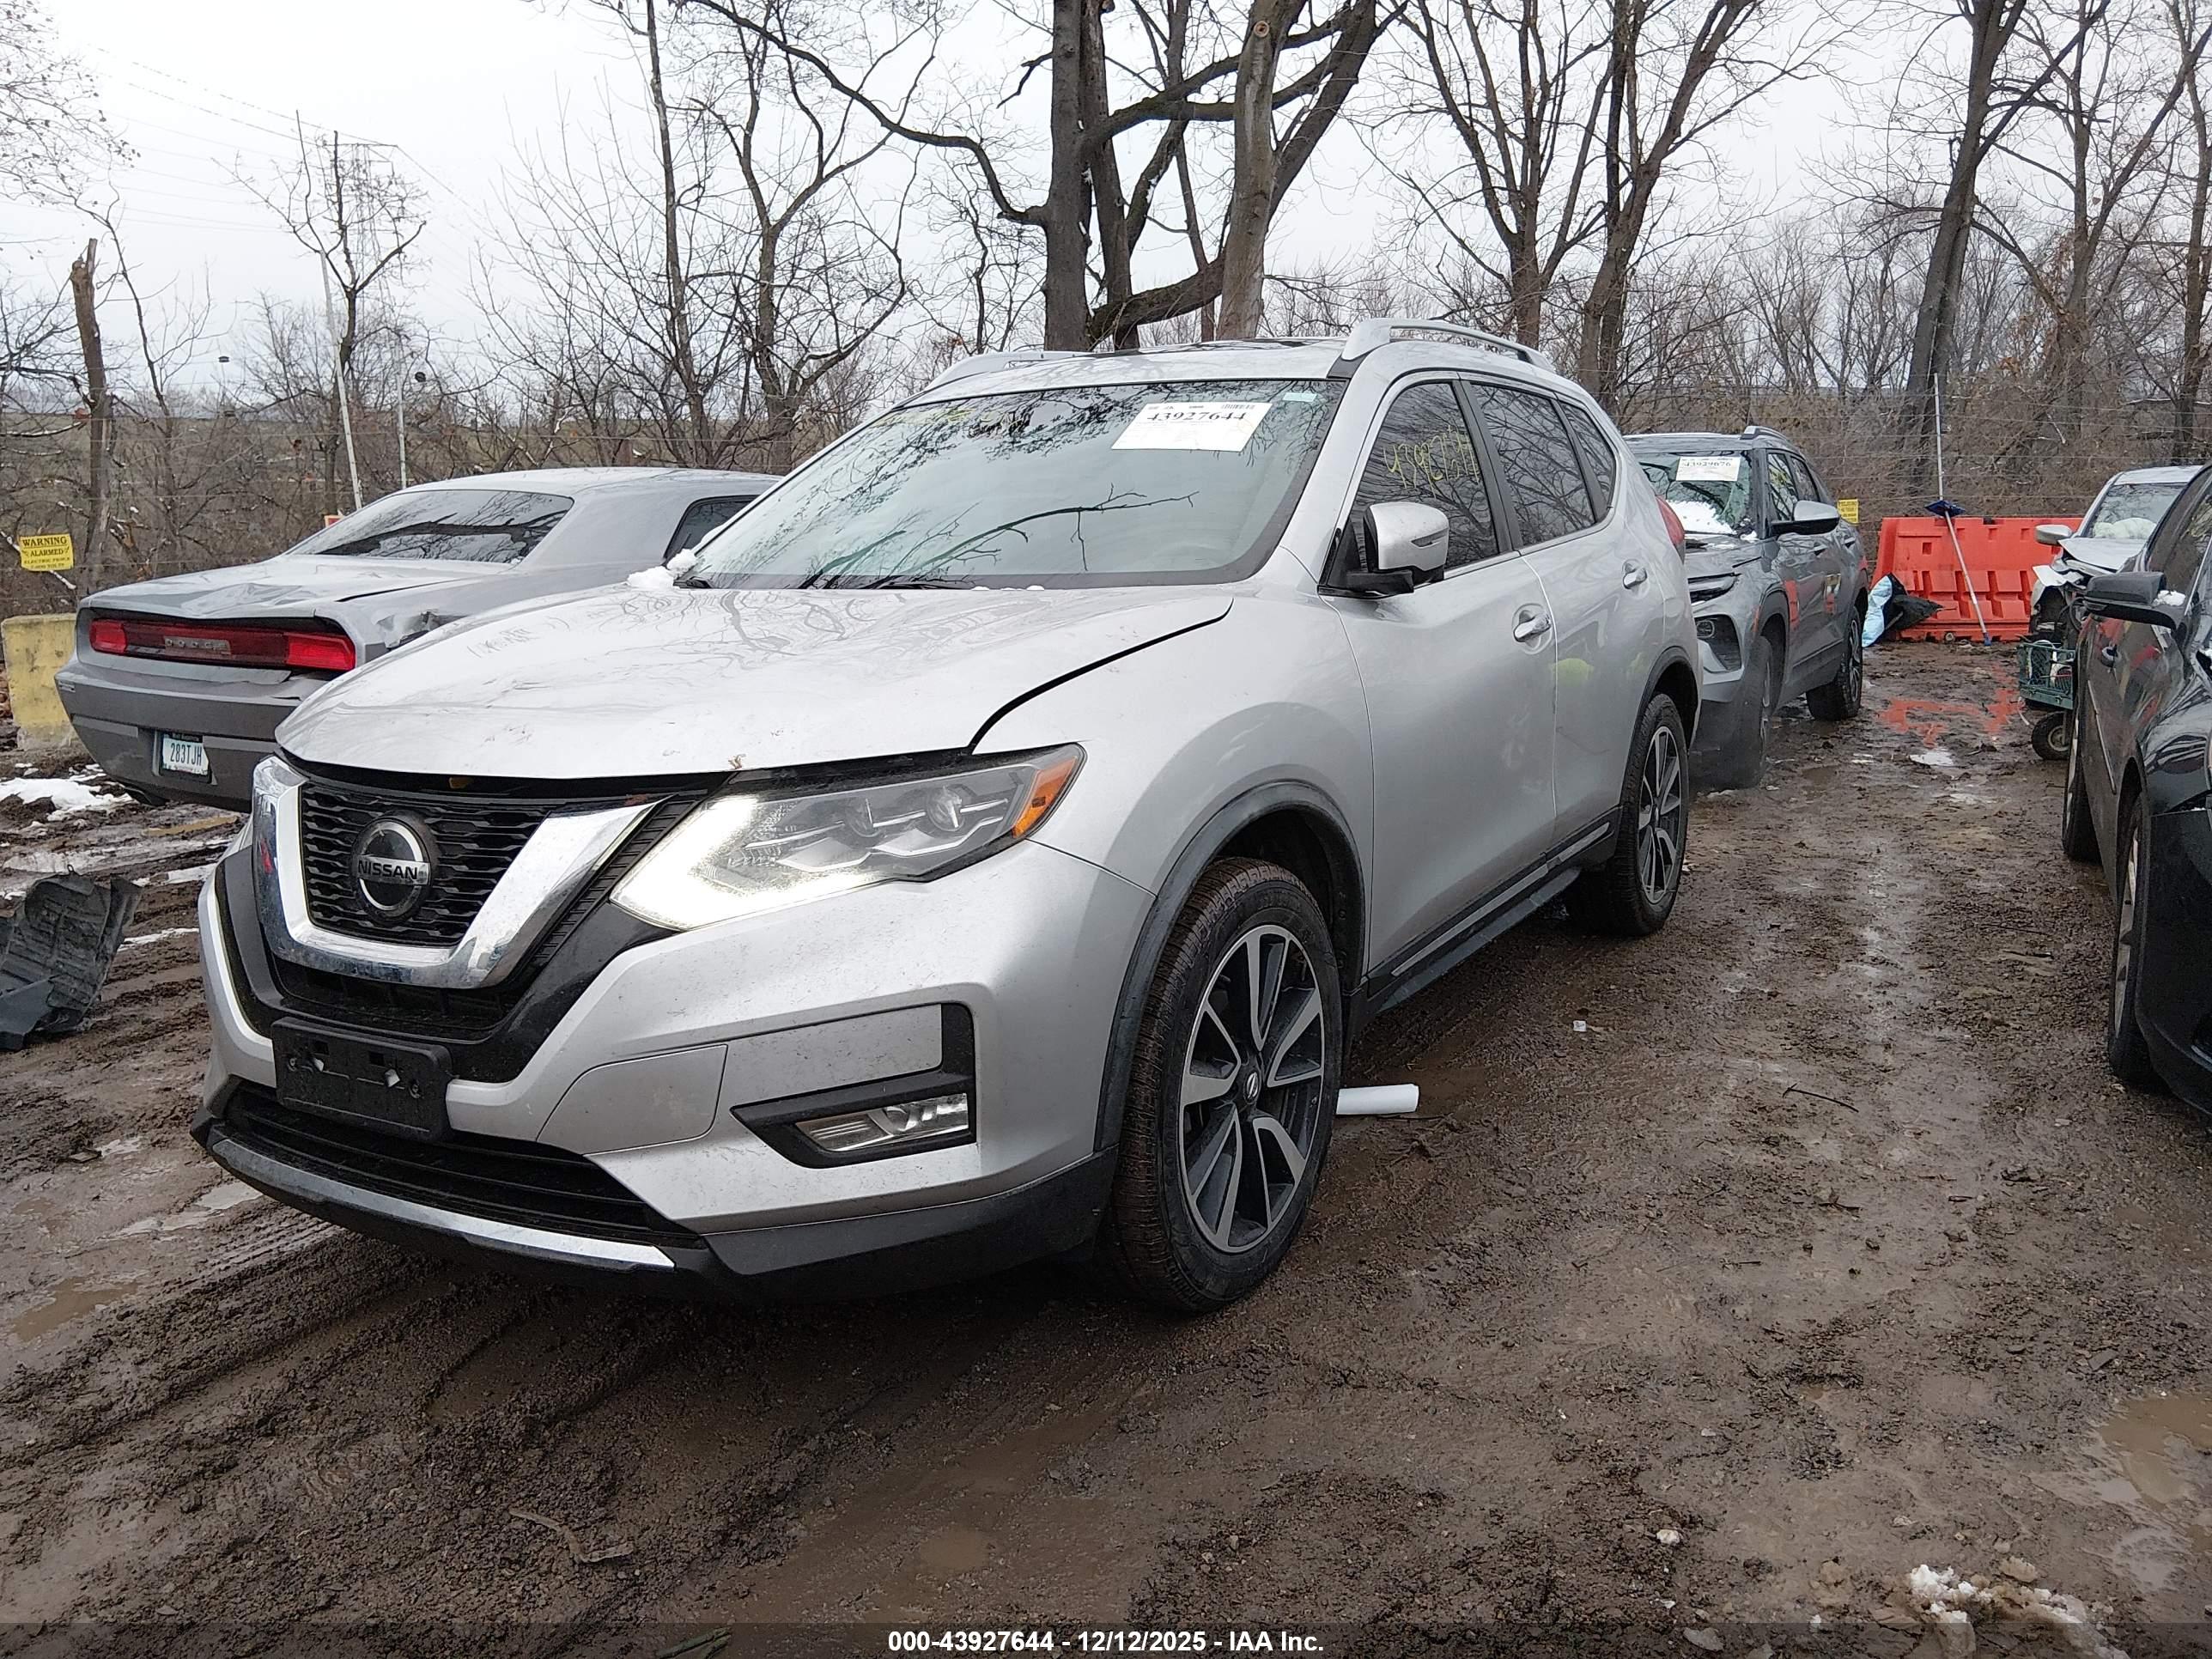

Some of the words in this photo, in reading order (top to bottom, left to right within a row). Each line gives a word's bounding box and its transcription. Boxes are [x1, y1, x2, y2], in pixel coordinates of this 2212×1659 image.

[1147, 412, 1246, 421] 43927644
[22, 537, 67, 546] WARNING
[170, 742, 203, 766] 283TJH
[357, 860, 418, 880] NISSAN
